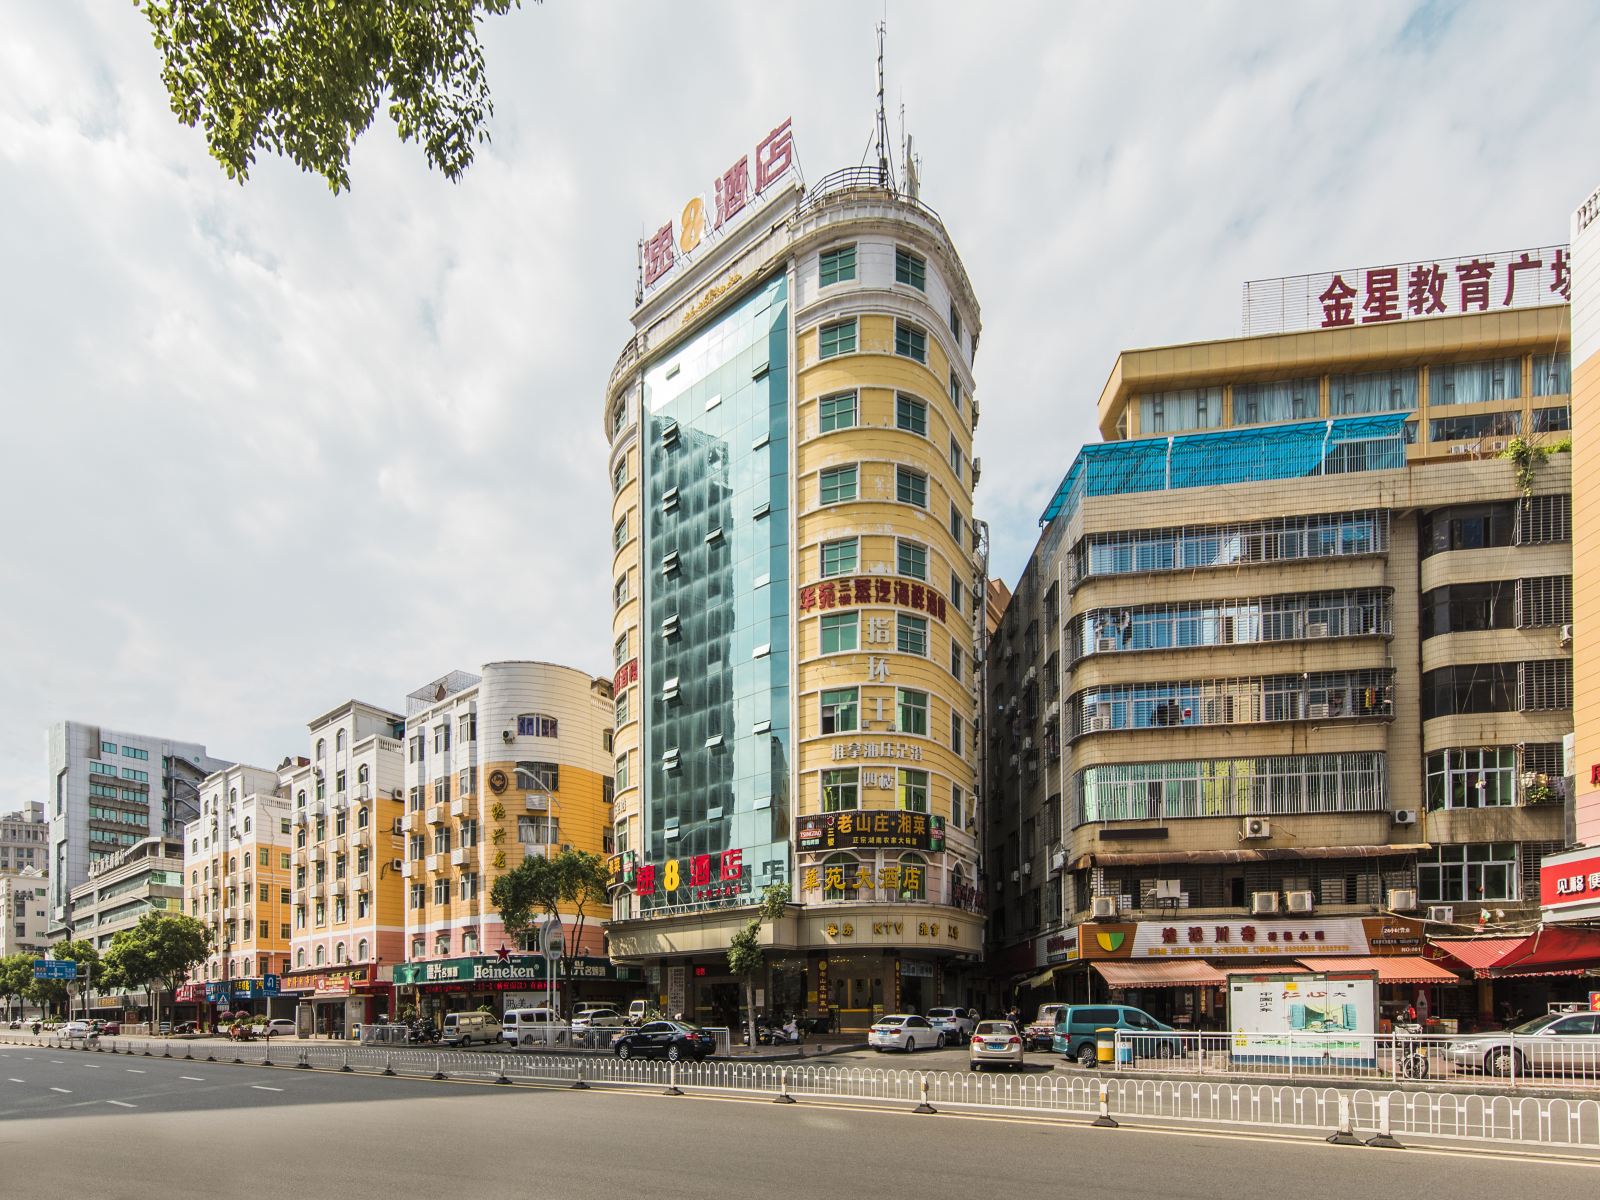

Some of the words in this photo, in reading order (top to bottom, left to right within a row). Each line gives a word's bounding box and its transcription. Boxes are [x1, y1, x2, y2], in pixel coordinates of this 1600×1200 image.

[643, 116, 792, 289] 速8酒店
[863, 771, 894, 790] 四楼
[636, 848, 743, 896] 速8酒店
[874, 921, 904, 936] KTV
[473, 964, 535, 979] Heineken
